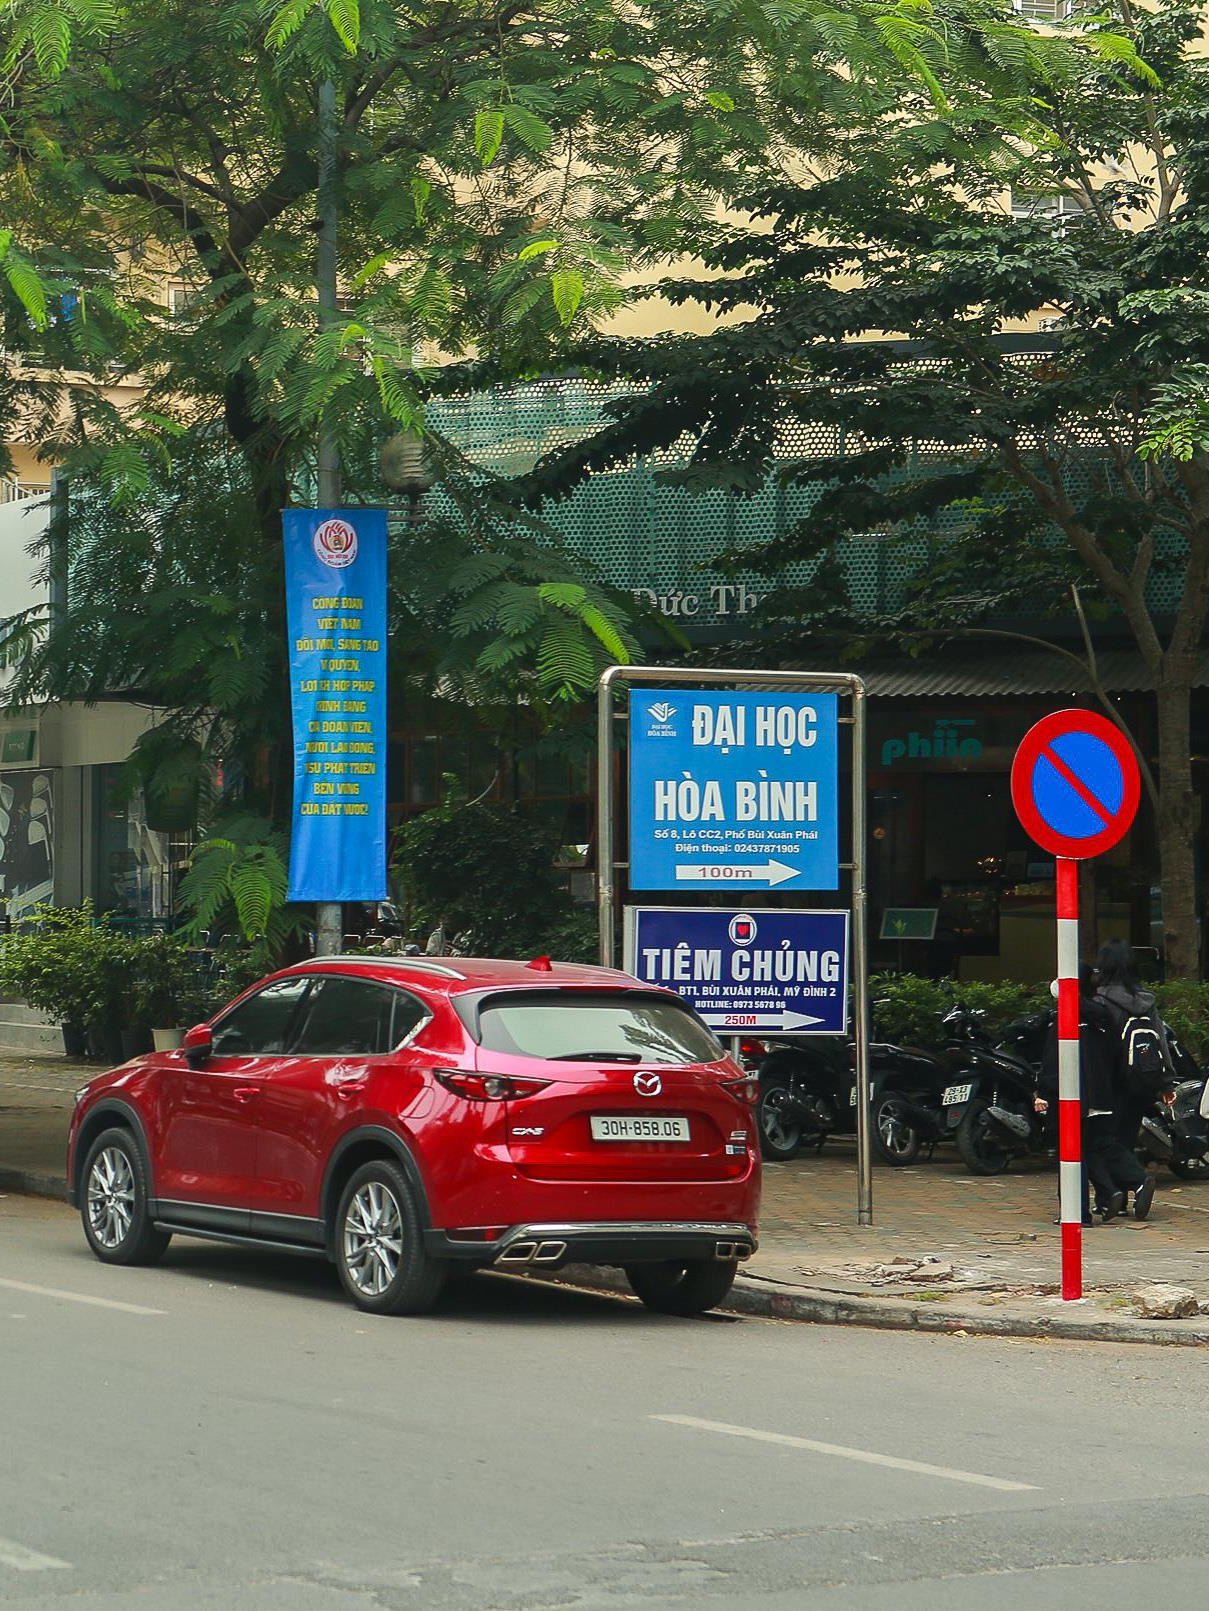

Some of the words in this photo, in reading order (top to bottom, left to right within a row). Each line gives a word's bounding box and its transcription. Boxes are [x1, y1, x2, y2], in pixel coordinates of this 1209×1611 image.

[711, 585, 768, 615] Th
[692, 705, 745, 754] ĐẠI
[755, 706, 817, 755] HỌC
[654, 771, 725, 821] HÒA
[736, 770, 818, 821] BÌNH
[654, 828, 669, 839] Số
[682, 829, 696, 839] Lô
[698, 830, 724, 840] CC2,
[725, 827, 745, 839] Phố
[747, 829, 765, 840] Bùi
[766, 829, 793, 840] Xuân
[795, 829, 818, 840] Phái
[675, 843, 699, 854] Điện
[701, 843, 731, 855] thoại:
[734, 843, 800, 854] 02437871905
[697, 866, 753, 879] 100m
[643, 942, 721, 980] TIÊM
[731, 939, 840, 982] CHỦNG
[722, 984, 752, 996] XUÂN
[783, 985, 800, 997] MỸ
[803, 984, 827, 997] ĐÌNH
[829, 987, 837, 997] 2
[695, 1000, 732, 1009] HOTLINE:
[724, 1015, 757, 1026] 250M
[601, 1120, 681, 1137] 30H-858.06
